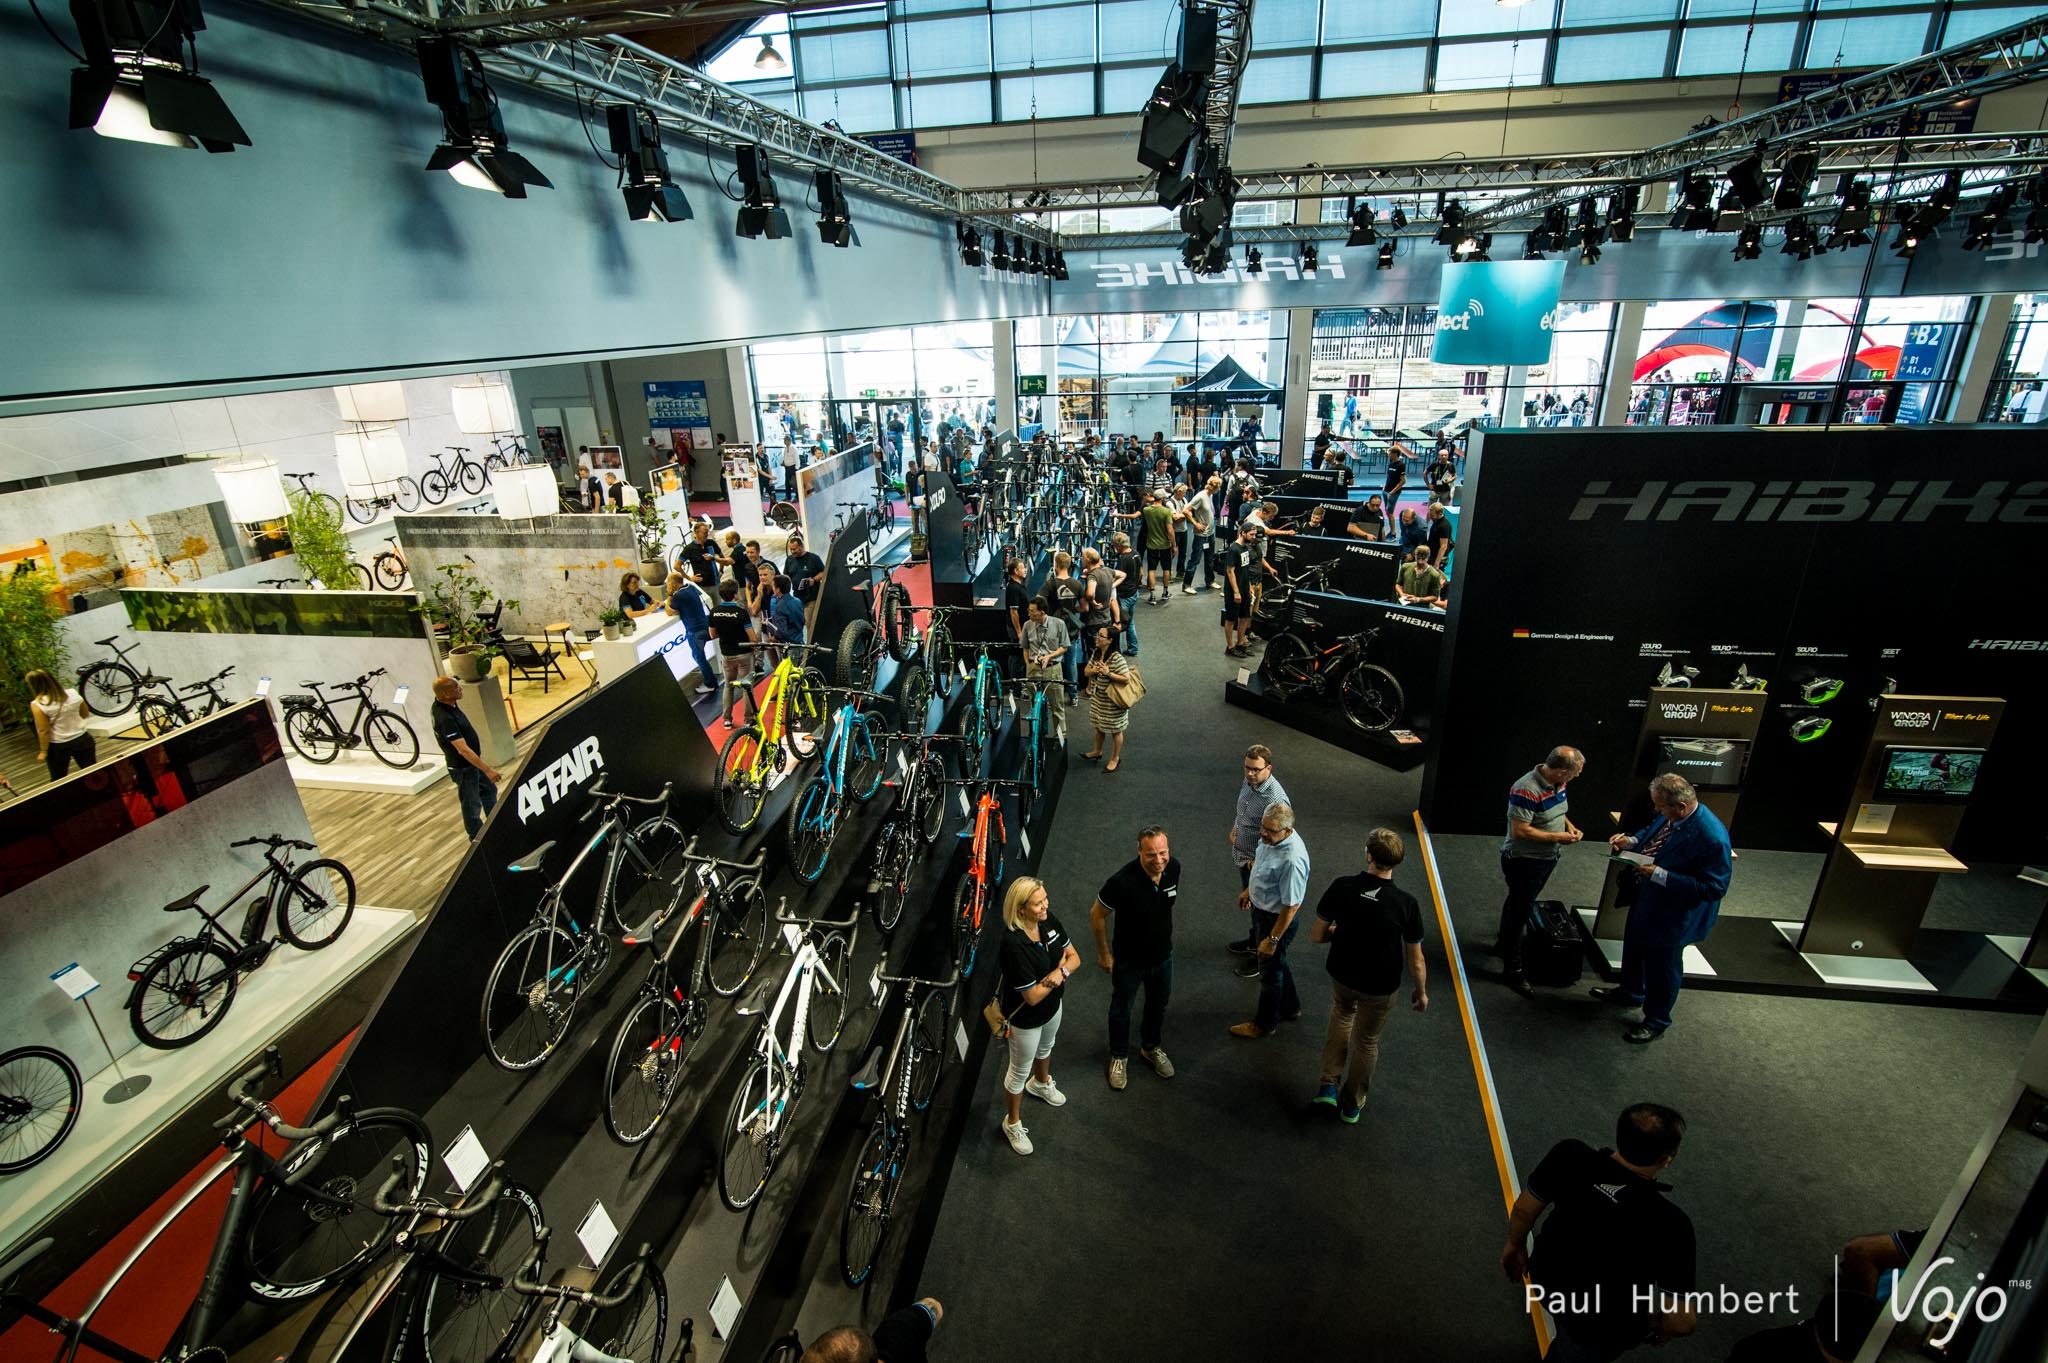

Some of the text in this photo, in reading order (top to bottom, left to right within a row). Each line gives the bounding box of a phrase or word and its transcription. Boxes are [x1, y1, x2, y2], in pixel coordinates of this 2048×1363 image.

[1854, 126, 1872, 137] A1
[1882, 125, 1901, 136] A7
[1916, 325, 1943, 346] B2
[1910, 356, 1919, 364] B1
[1302, 473, 1334, 482] HAIBIKE
[1320, 502, 1356, 513] HAIBIKE
[1346, 545, 1395, 560] HAIBIKE
[1385, 611, 1445, 632] HAIBIKE
[1968, 639, 2048, 651] HAIBI
[1661, 704, 1698, 712] WINORA
[1664, 711, 1697, 719] GROUP
[1891, 712, 1931, 720] WINORA
[1894, 720, 1929, 728] GROUP
[518, 735, 605, 826] AFFAIR
[250, 1278, 327, 1299] ZIPP
